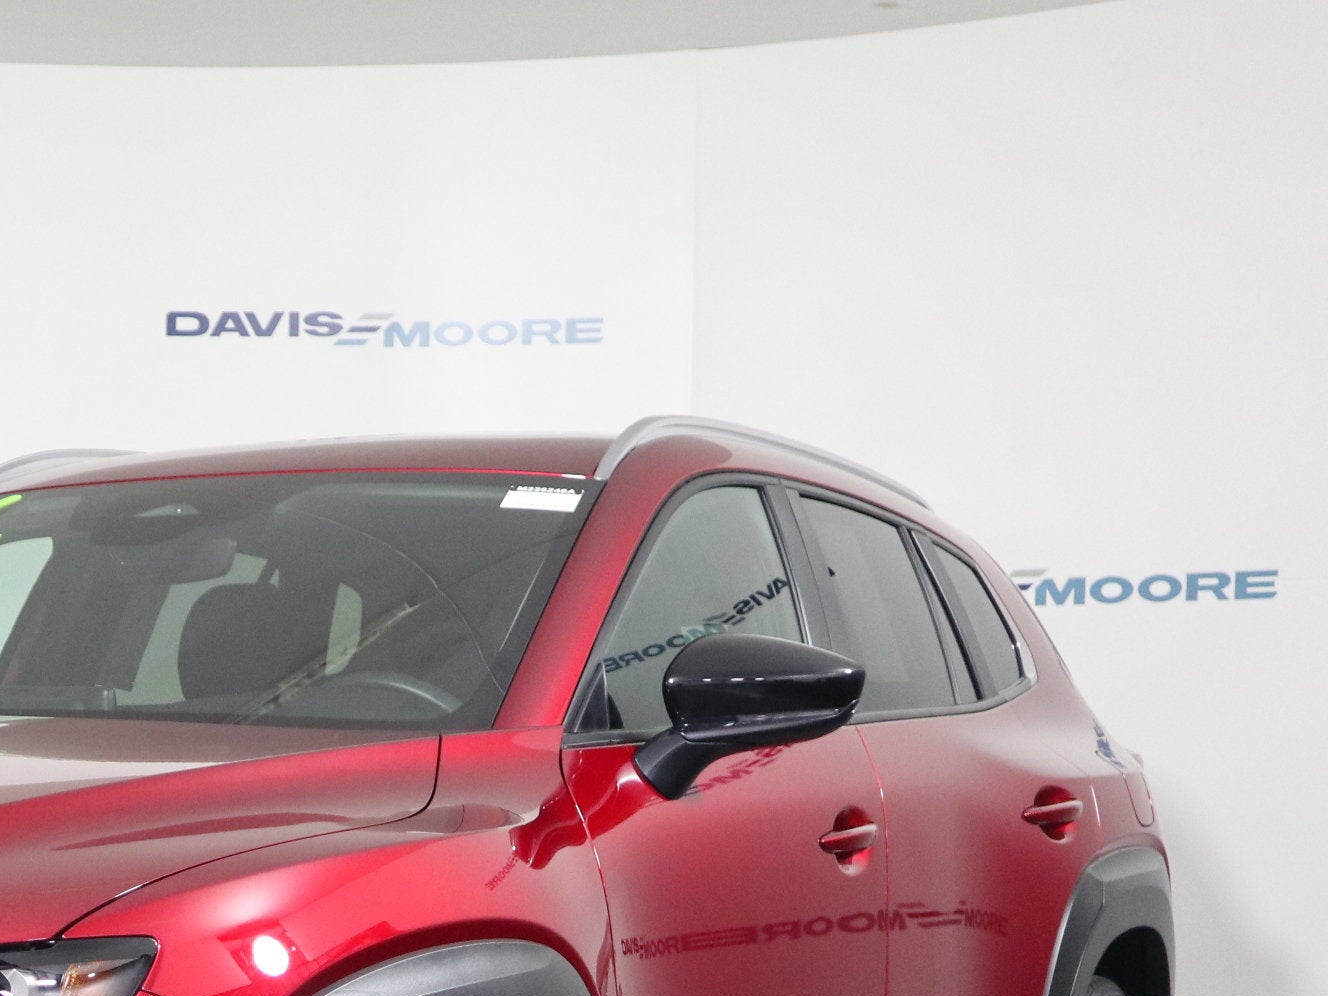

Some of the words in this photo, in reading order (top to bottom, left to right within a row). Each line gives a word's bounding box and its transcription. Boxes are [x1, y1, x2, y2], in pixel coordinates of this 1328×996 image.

[165, 311, 344, 338] DAVIS
[383, 317, 604, 348] MOORE
[1037, 570, 1279, 606] MOORE
